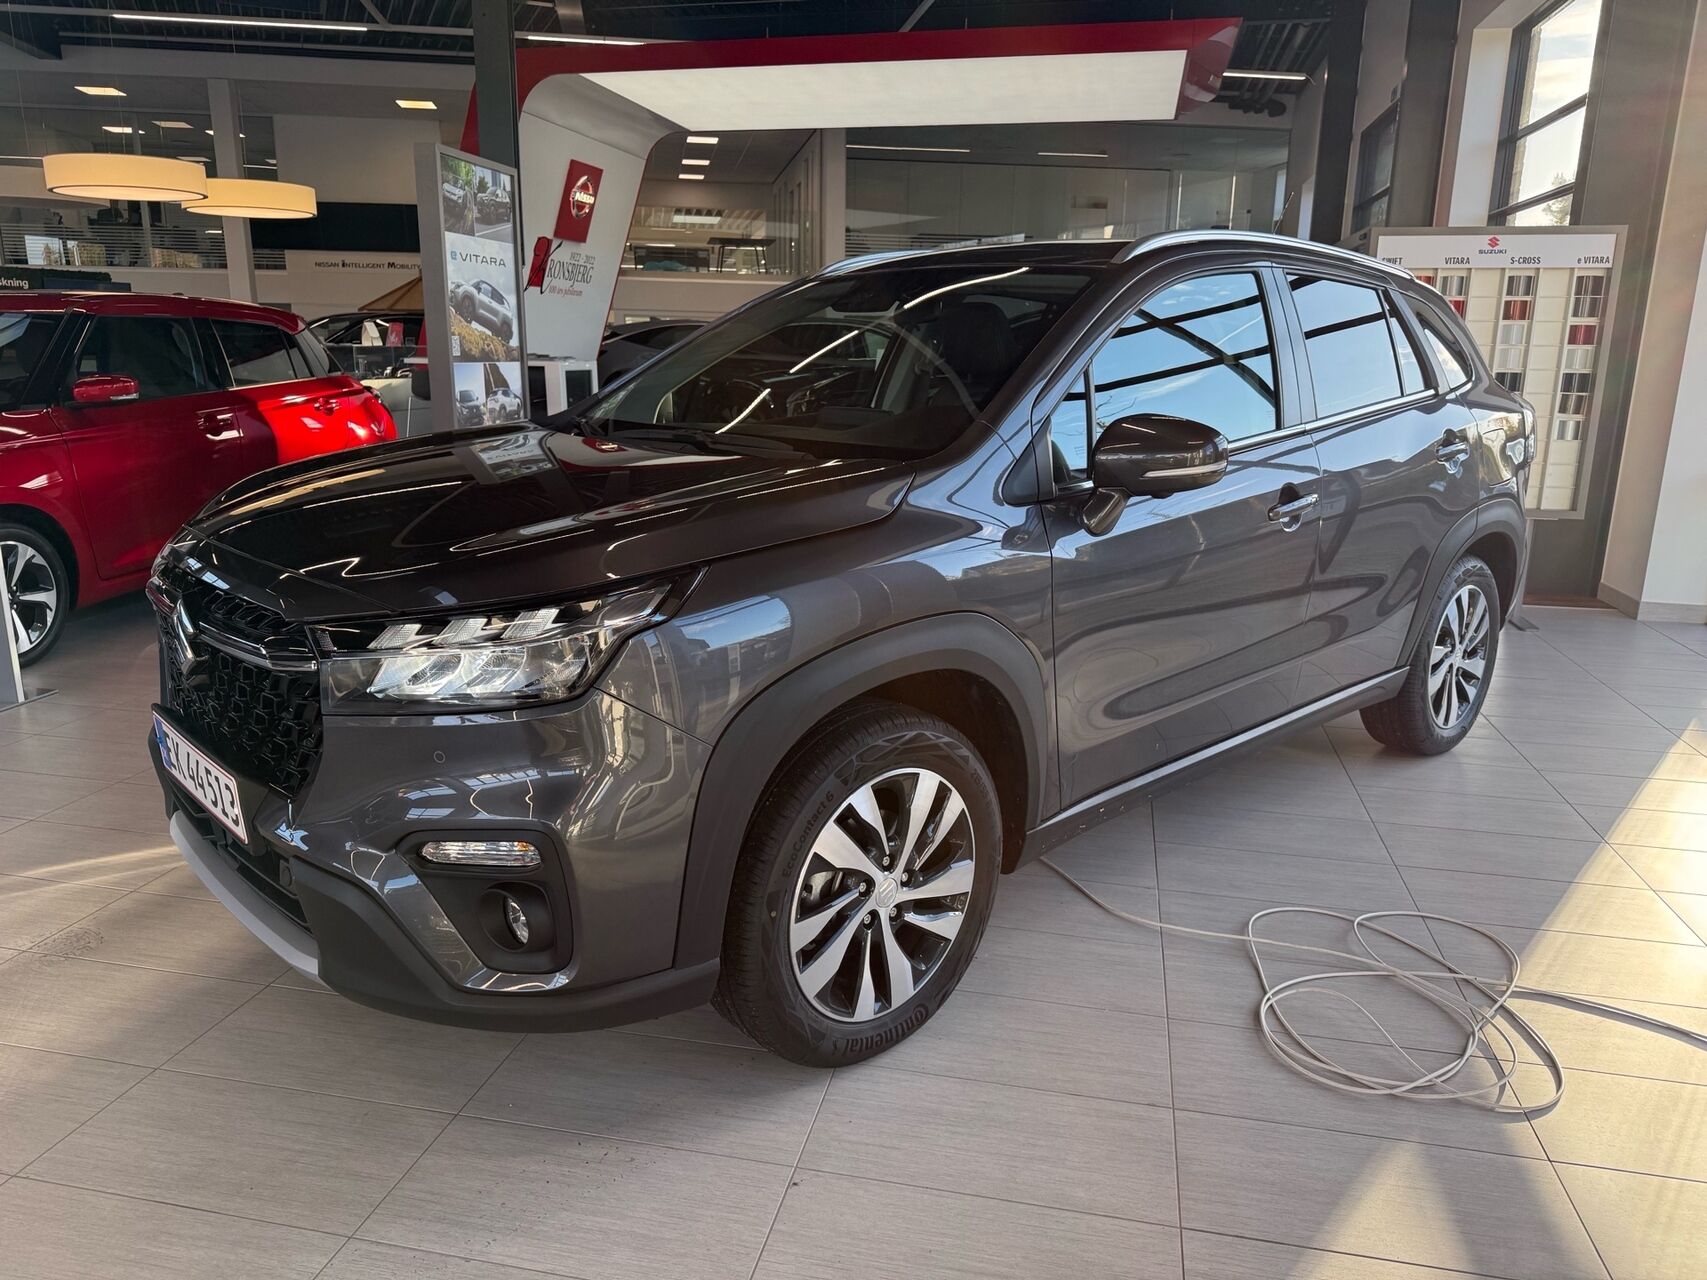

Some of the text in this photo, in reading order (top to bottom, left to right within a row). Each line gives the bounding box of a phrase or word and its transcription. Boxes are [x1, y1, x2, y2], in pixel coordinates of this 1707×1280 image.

[459, 252, 506, 268] VITARA
[1444, 257, 1470, 265] VITARA
[1510, 256, 1541, 265] S-CROSS
[1583, 256, 1610, 264] VITARA
[0, 277, 29, 289] kning
[783, 791, 834, 878] EcoContact 6
[842, 1003, 929, 1056] Continental
